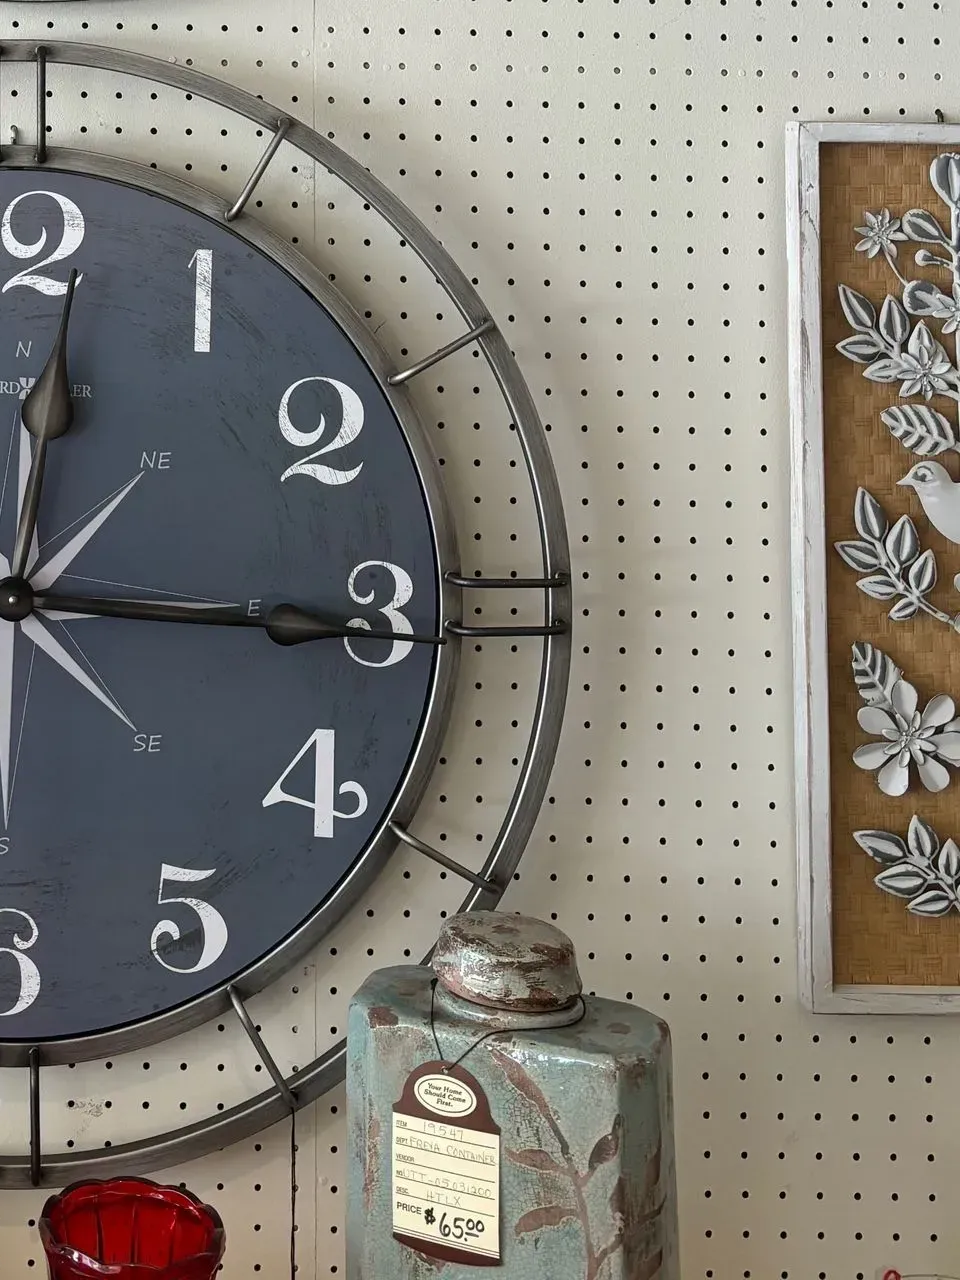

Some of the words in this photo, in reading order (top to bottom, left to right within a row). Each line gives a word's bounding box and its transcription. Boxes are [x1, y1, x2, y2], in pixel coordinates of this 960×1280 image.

[187, 249, 213, 353] 1
[15, 340, 32, 358] N
[278, 375, 365, 485] 2
[140, 450, 172, 470] NE
[247, 598, 262, 618] E
[343, 560, 415, 668] 3
[133, 734, 162, 753] SE
[262, 728, 368, 838] 4
[150, 863, 229, 974] 5
[423, 1088, 446, 1099] Should
[447, 1093, 466, 1103] Come
[427, 1082, 442, 1091] Your
[443, 1085, 463, 1096] Home
[396, 1119, 408, 1127] ITEM
[422, 1121, 464, 1141] 19547
[395, 1153, 415, 1162] VENDOR
[396, 1201, 422, 1215] PRICE
